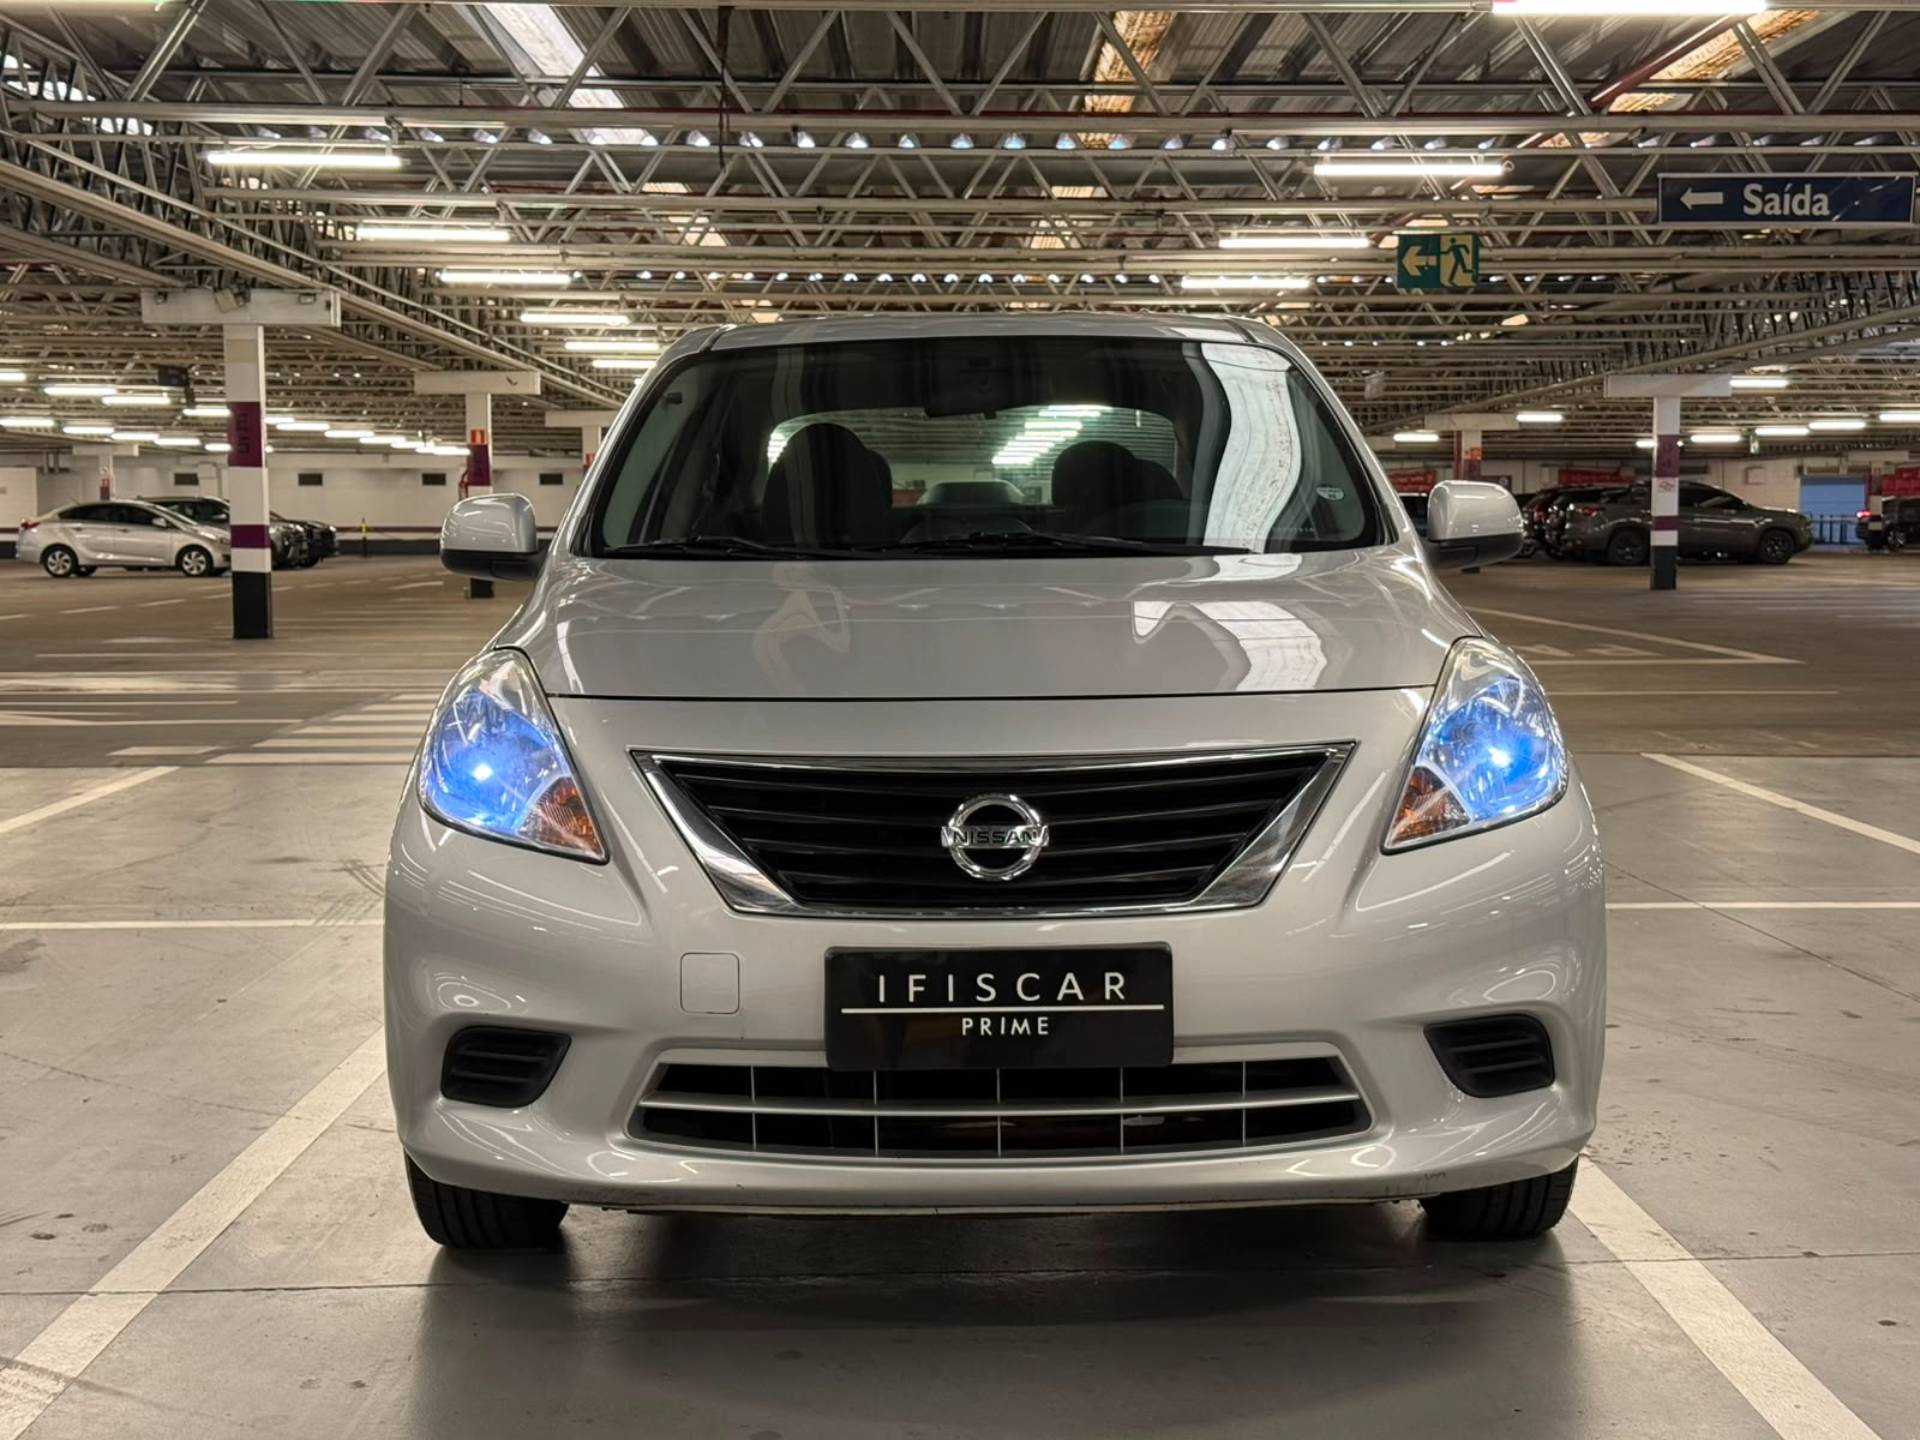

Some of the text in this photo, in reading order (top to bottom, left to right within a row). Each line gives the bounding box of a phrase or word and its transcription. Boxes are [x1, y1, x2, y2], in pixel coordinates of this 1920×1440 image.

[1743, 183, 1830, 216] Saída
[952, 829, 1037, 844] NISSAN
[878, 972, 1126, 1003] IFISCAR
[961, 1016, 1050, 1036] PRIME
